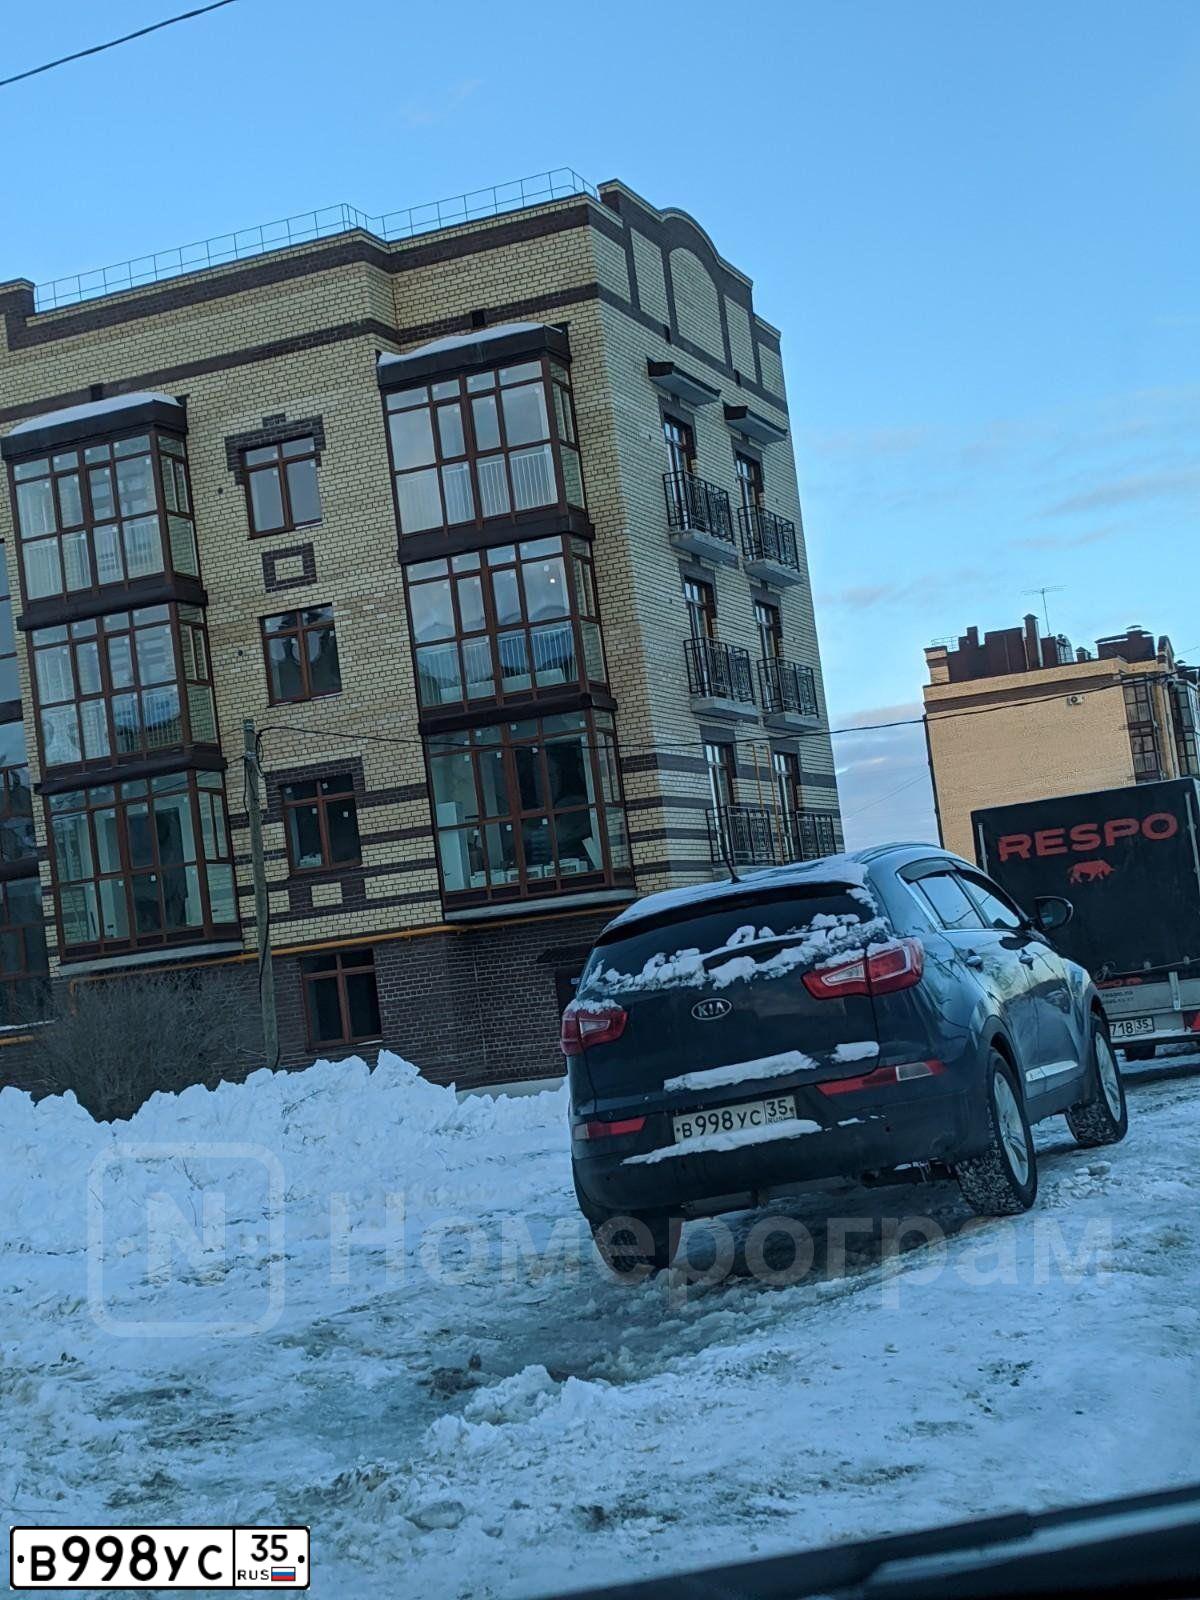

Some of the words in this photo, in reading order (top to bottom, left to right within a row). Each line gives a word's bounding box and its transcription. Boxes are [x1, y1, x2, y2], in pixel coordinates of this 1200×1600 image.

[996, 812, 1179, 863] RESPO
[698, 1002, 726, 1017] KIA
[1136, 1018, 1149, 1030] 35
[766, 1099, 788, 1117] 35
